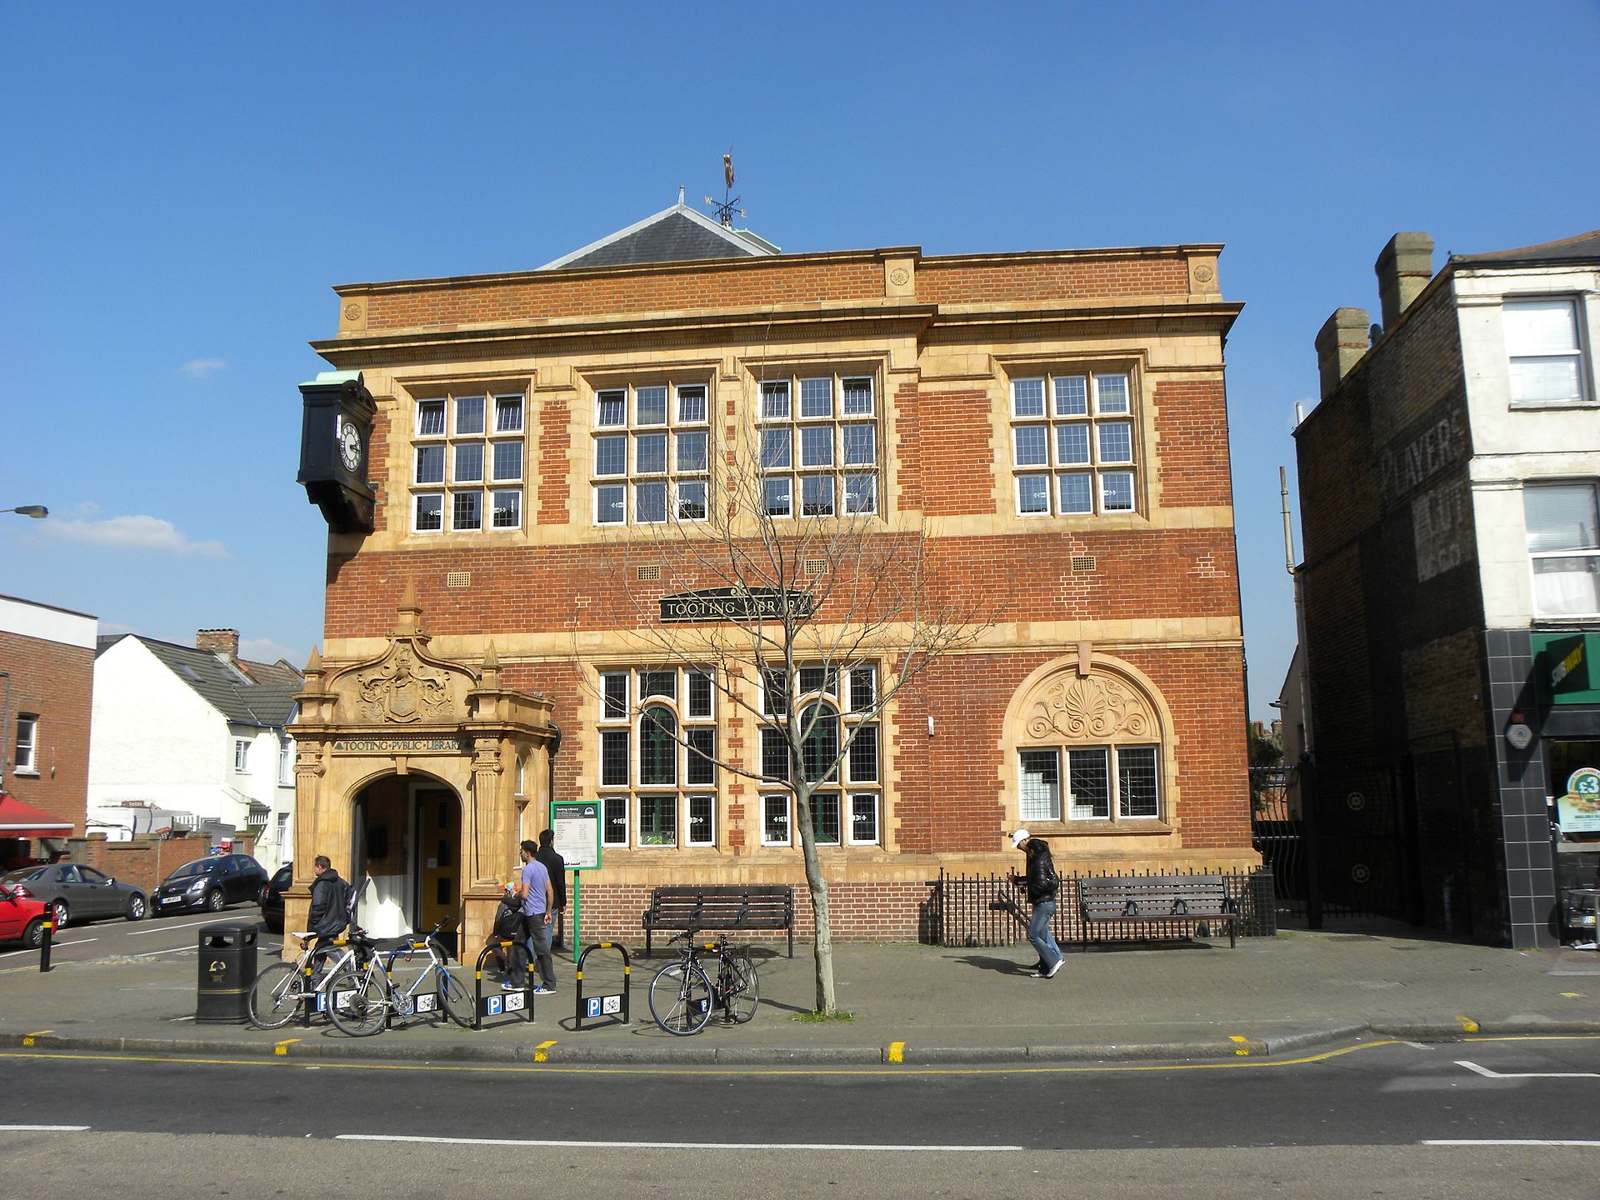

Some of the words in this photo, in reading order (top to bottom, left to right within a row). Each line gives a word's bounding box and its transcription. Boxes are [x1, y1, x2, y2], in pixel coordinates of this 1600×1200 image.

[667, 602, 735, 615] TOOTING
[1551, 641, 1584, 687] SUBWAY
[344, 741, 388, 751] TOOTING
[491, 998, 499, 1013] P
[591, 1000, 598, 1014] P
